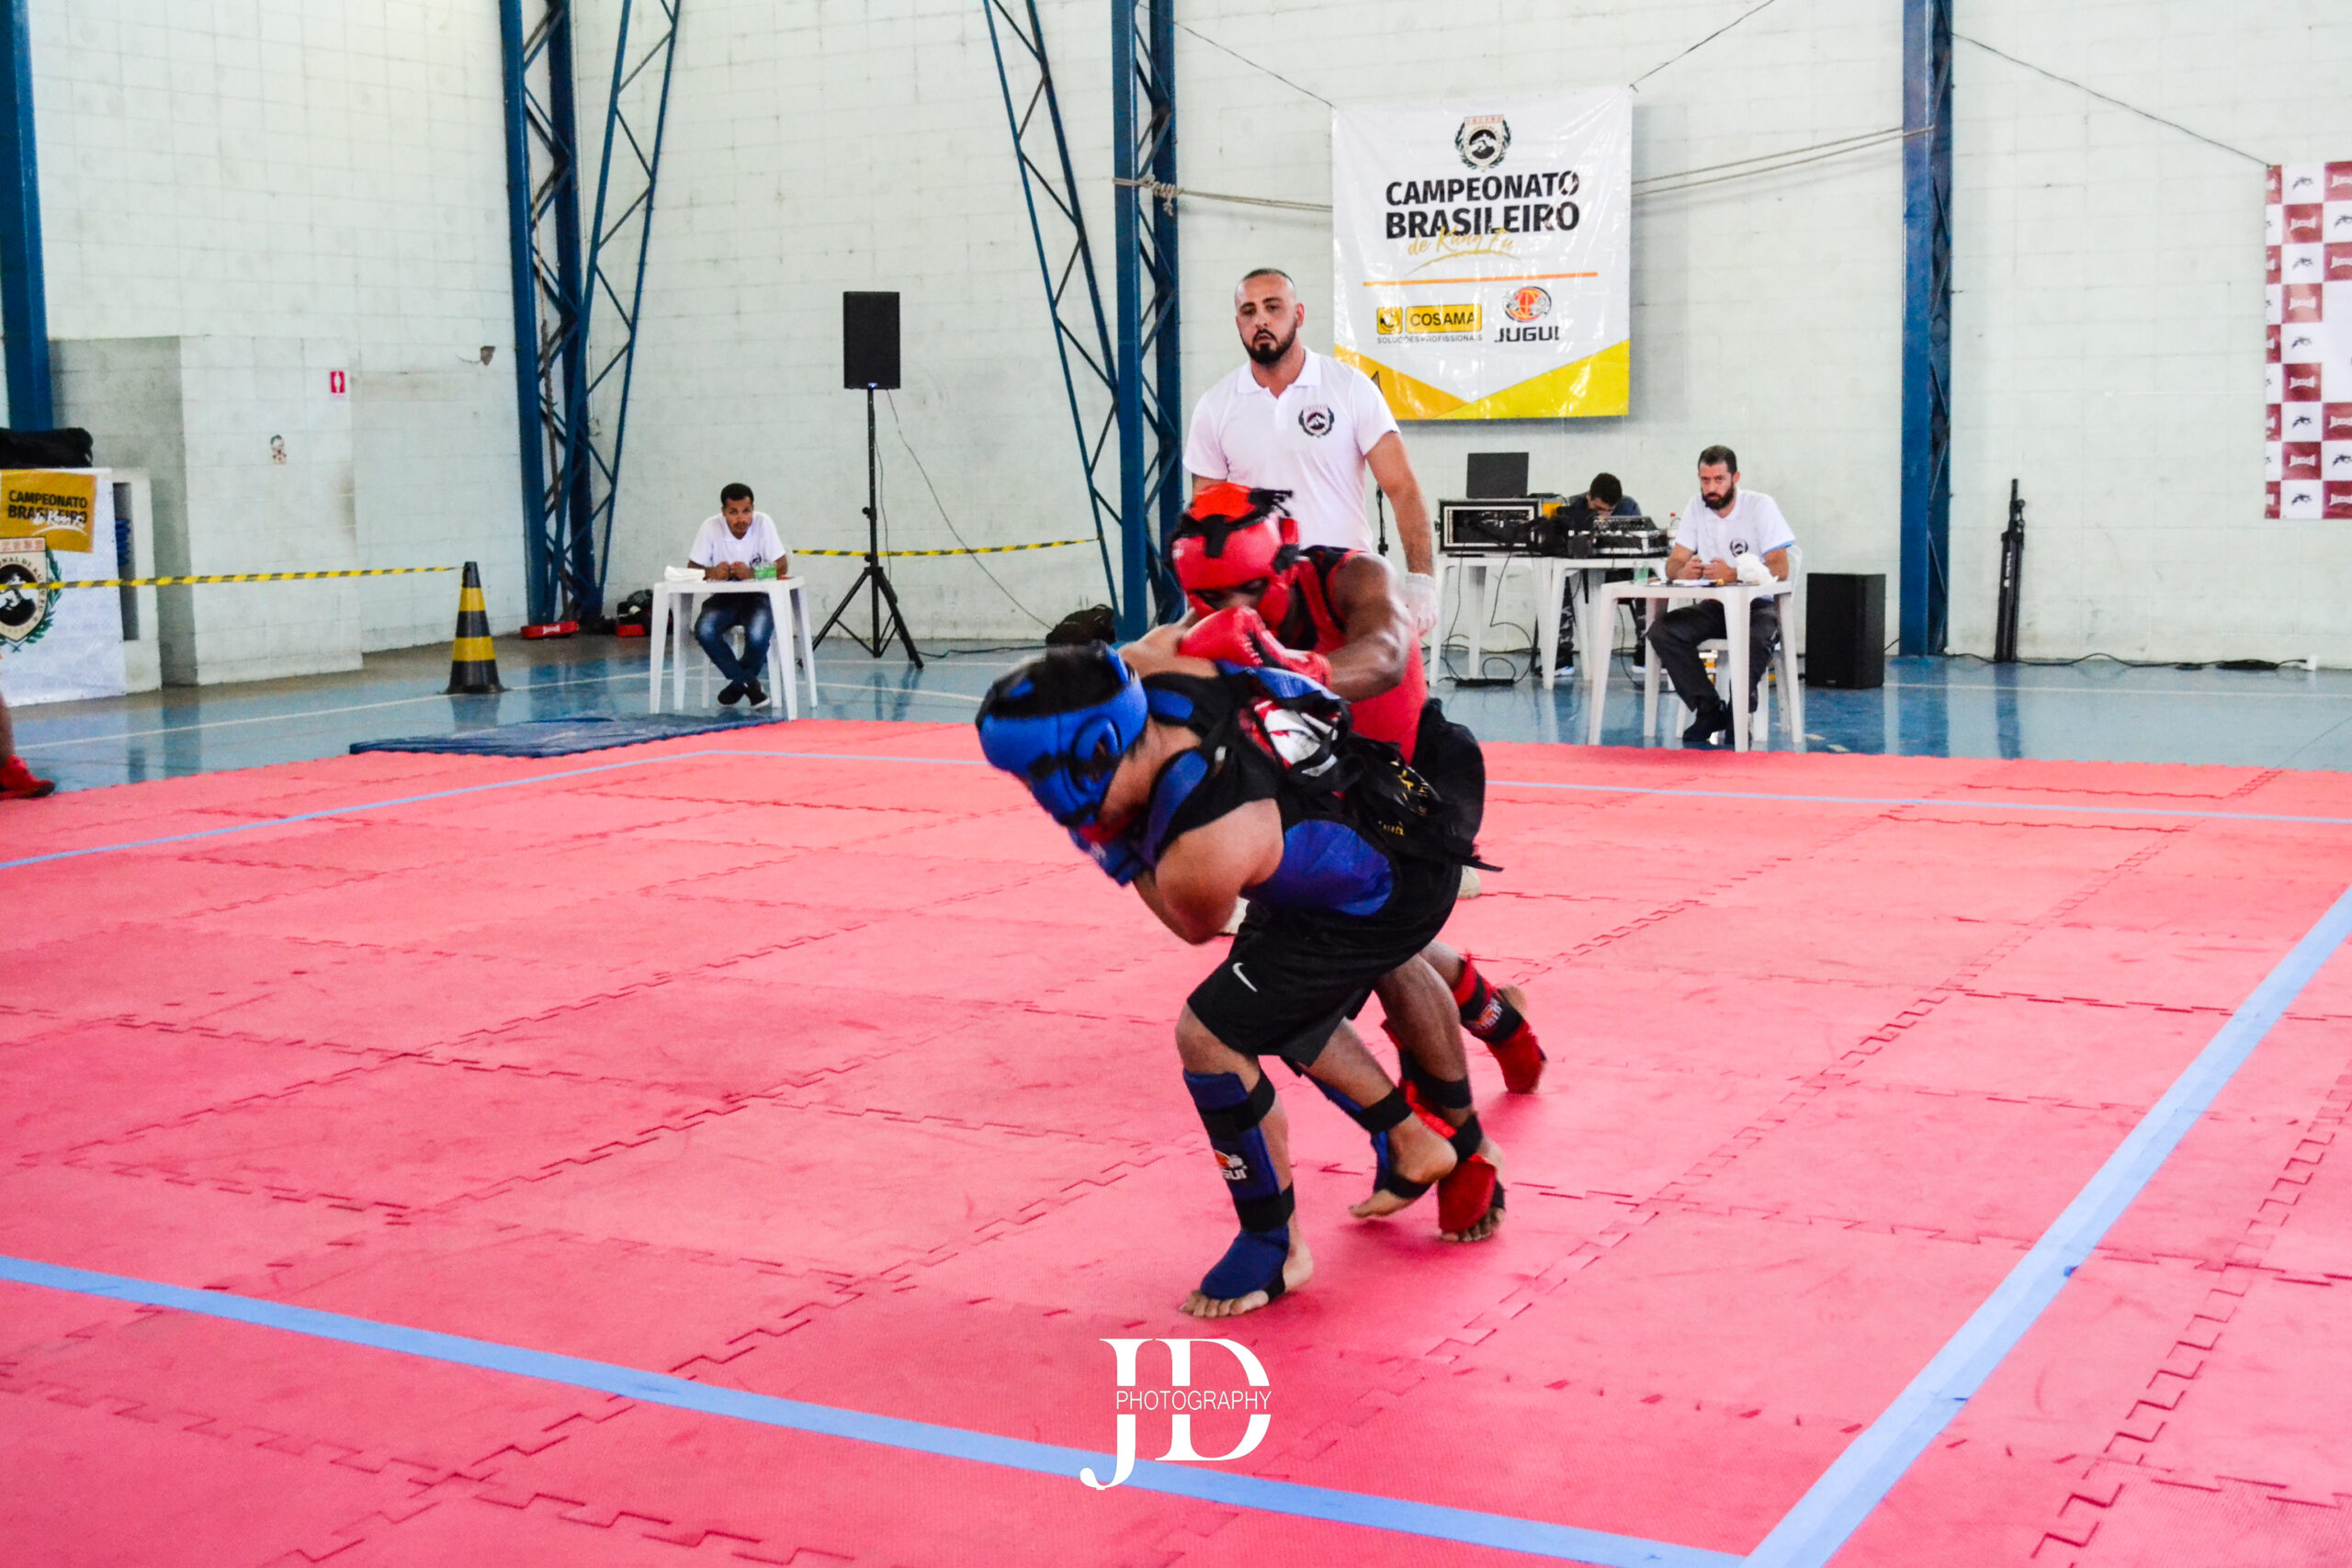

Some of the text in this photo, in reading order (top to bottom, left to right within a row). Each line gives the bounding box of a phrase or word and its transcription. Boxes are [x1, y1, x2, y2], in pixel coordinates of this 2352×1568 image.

[1385, 171, 1579, 206] CAMPEONATO
[1386, 201, 1579, 239] BRASILEIRO
[1408, 232, 1430, 254] de
[1436, 225, 1483, 252] Kung
[1410, 312, 1476, 326] COSAMA
[1421, 334, 1483, 343] PROFISSIONAS
[8, 491, 87, 508] CAMPEONATO
[8, 504, 87, 524] BRASIEIRO
